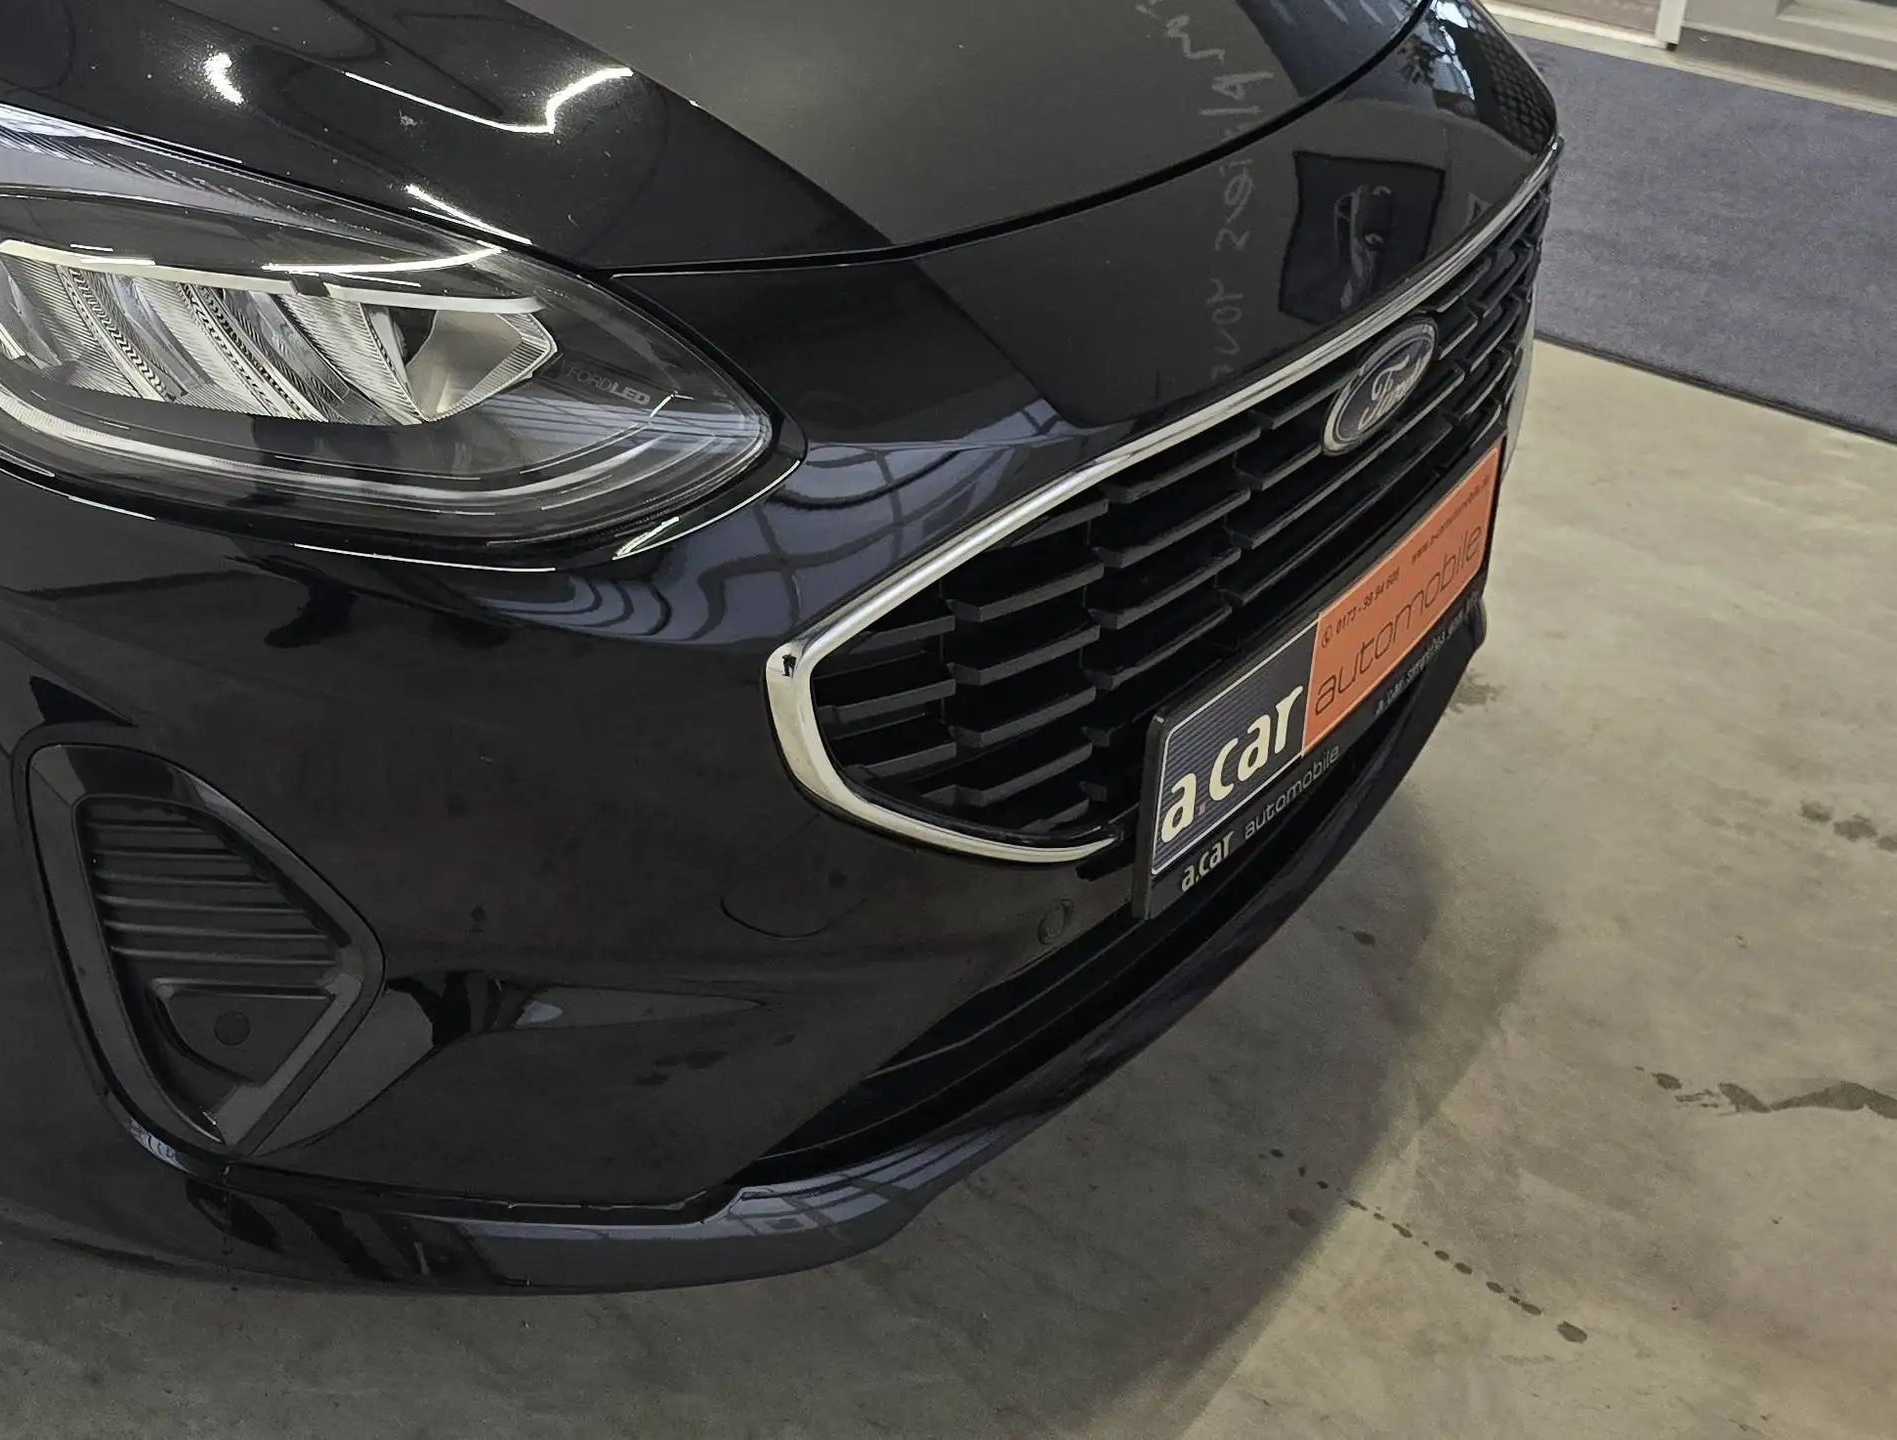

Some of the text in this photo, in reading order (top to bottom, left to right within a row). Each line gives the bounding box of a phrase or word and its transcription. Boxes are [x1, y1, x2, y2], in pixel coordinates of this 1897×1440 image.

[1358, 355, 1423, 433] Ford
[1314, 525, 1482, 717] automobile
[1180, 744, 1341, 893] a.car automobile
